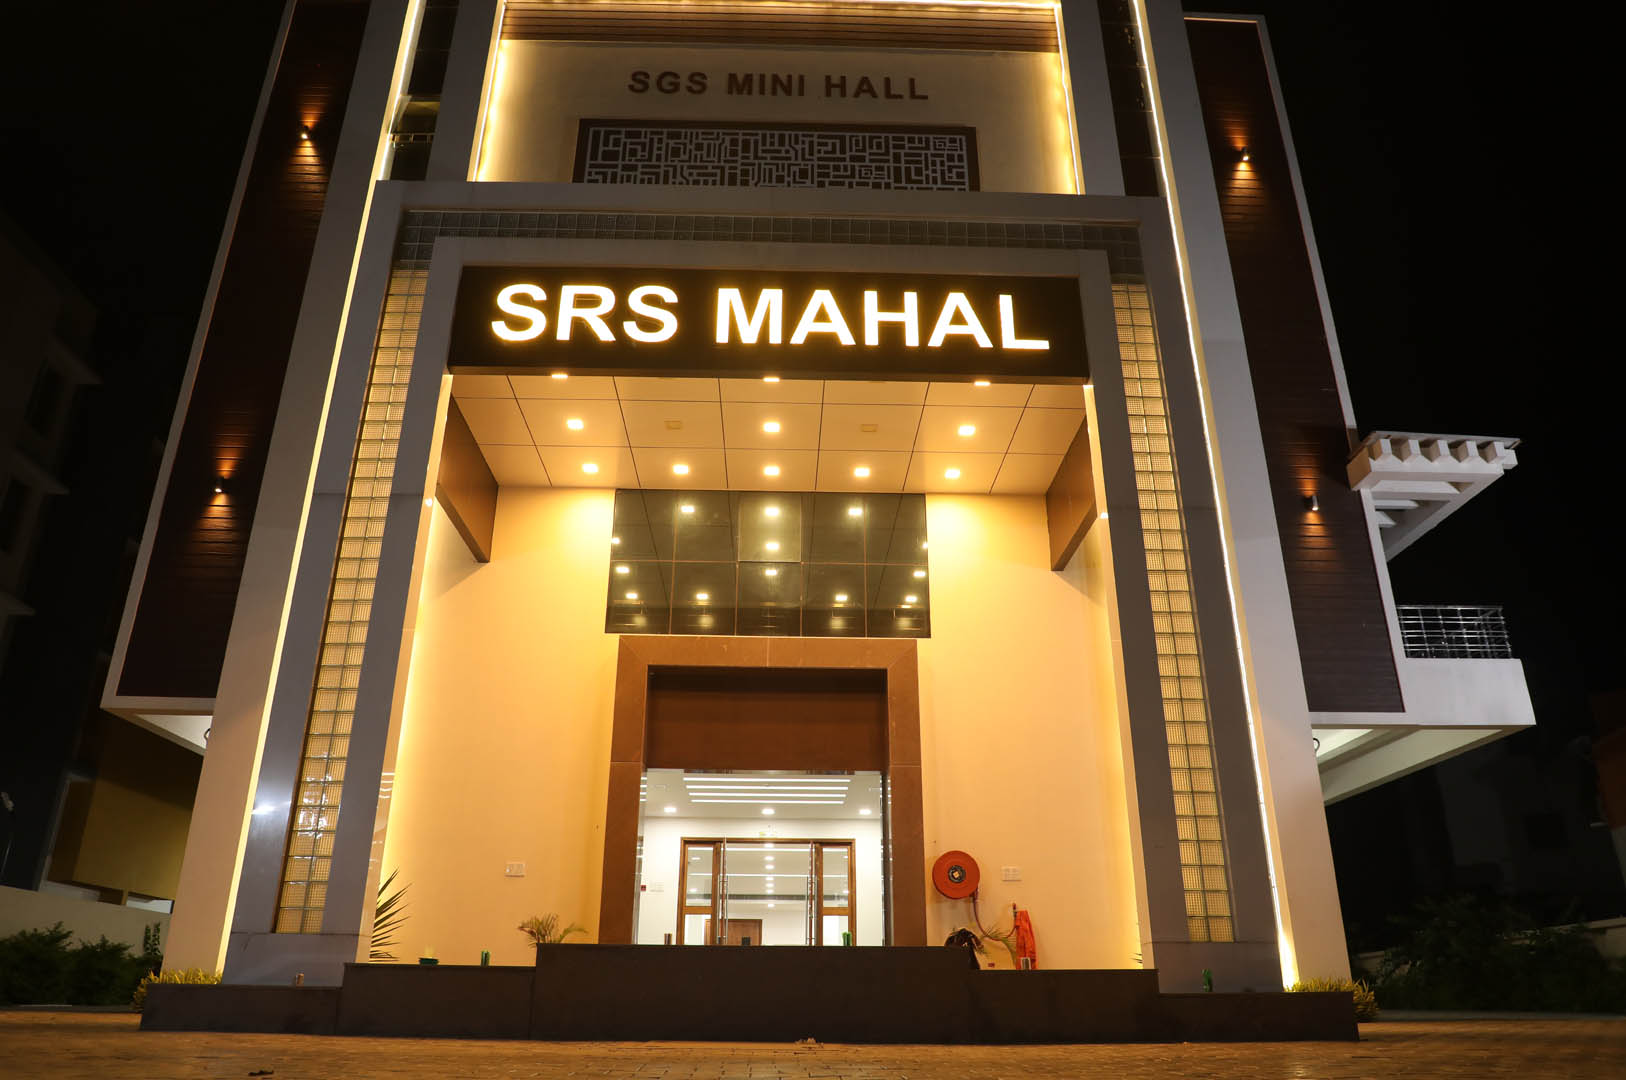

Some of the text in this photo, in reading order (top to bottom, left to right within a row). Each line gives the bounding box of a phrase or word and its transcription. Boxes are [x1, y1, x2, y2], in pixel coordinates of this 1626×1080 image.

[628, 71, 928, 100] SGS MINI HALL
[490, 283, 1050, 350] SRS MAHAL
